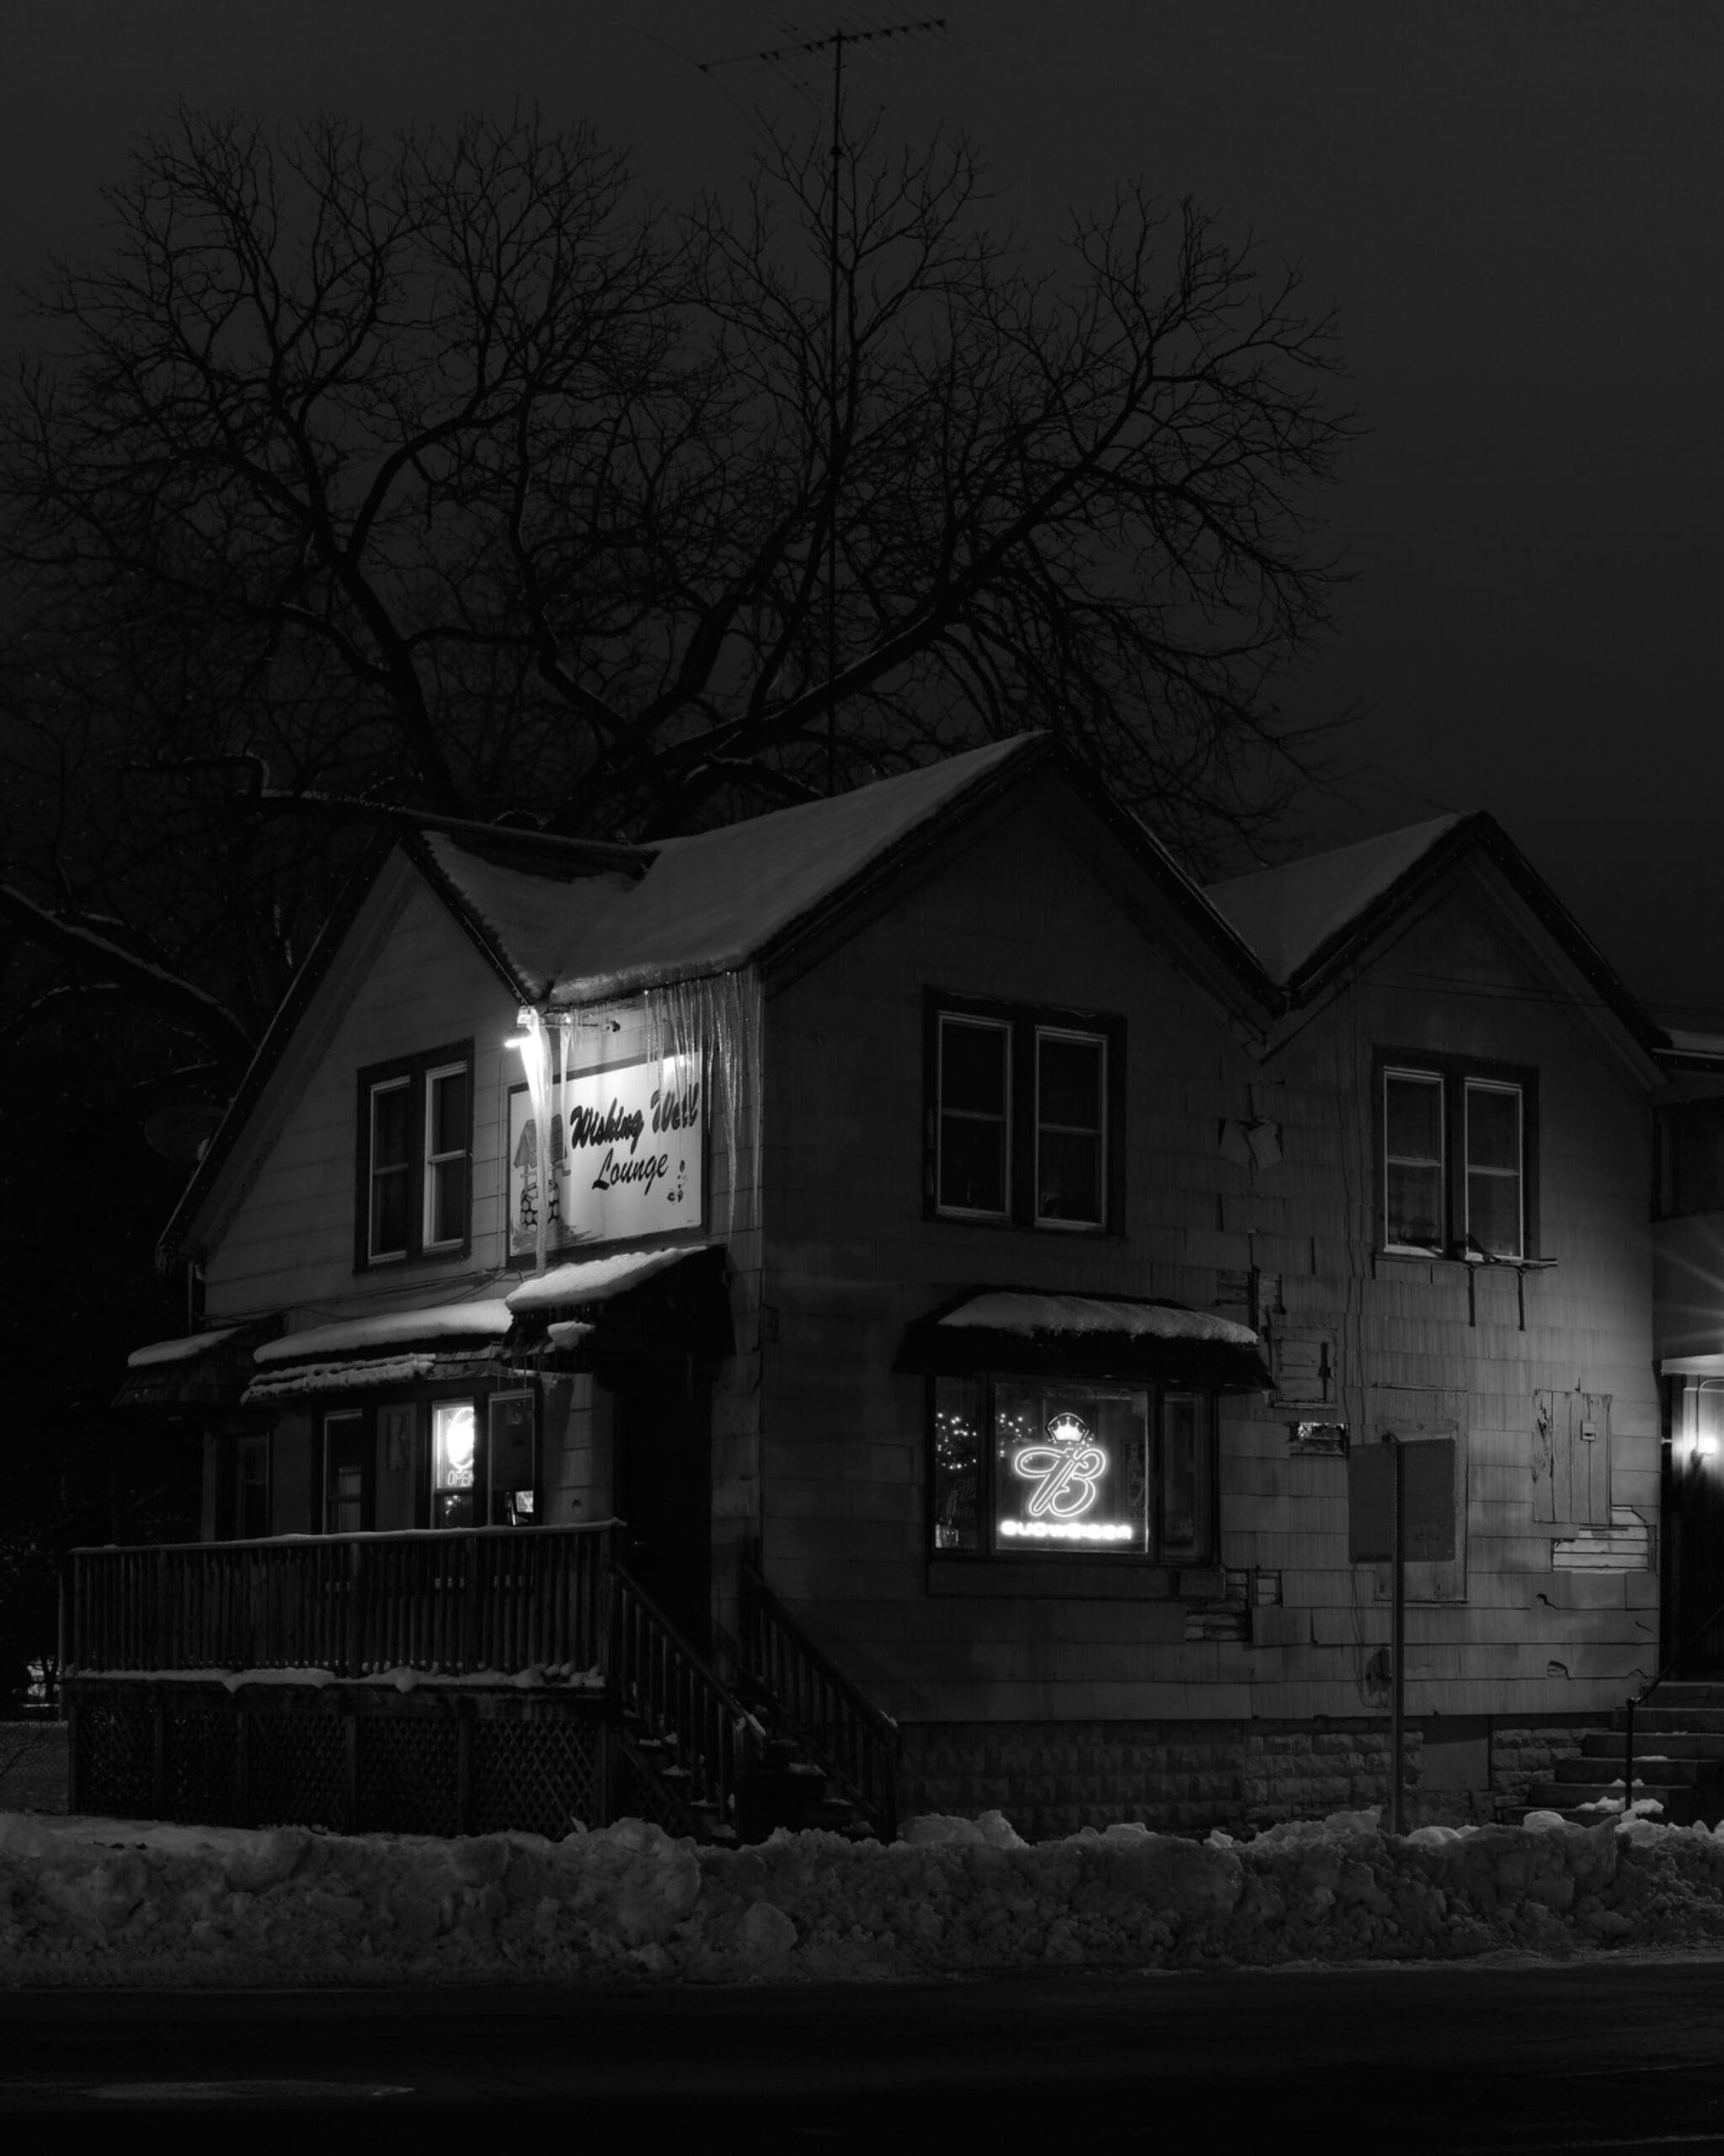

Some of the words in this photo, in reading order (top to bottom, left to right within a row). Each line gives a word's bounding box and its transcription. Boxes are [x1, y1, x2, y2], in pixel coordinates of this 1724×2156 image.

[570, 1097, 644, 1155] Wishing
[650, 1082, 700, 1134] Well
[592, 1147, 669, 1196] Lounge
